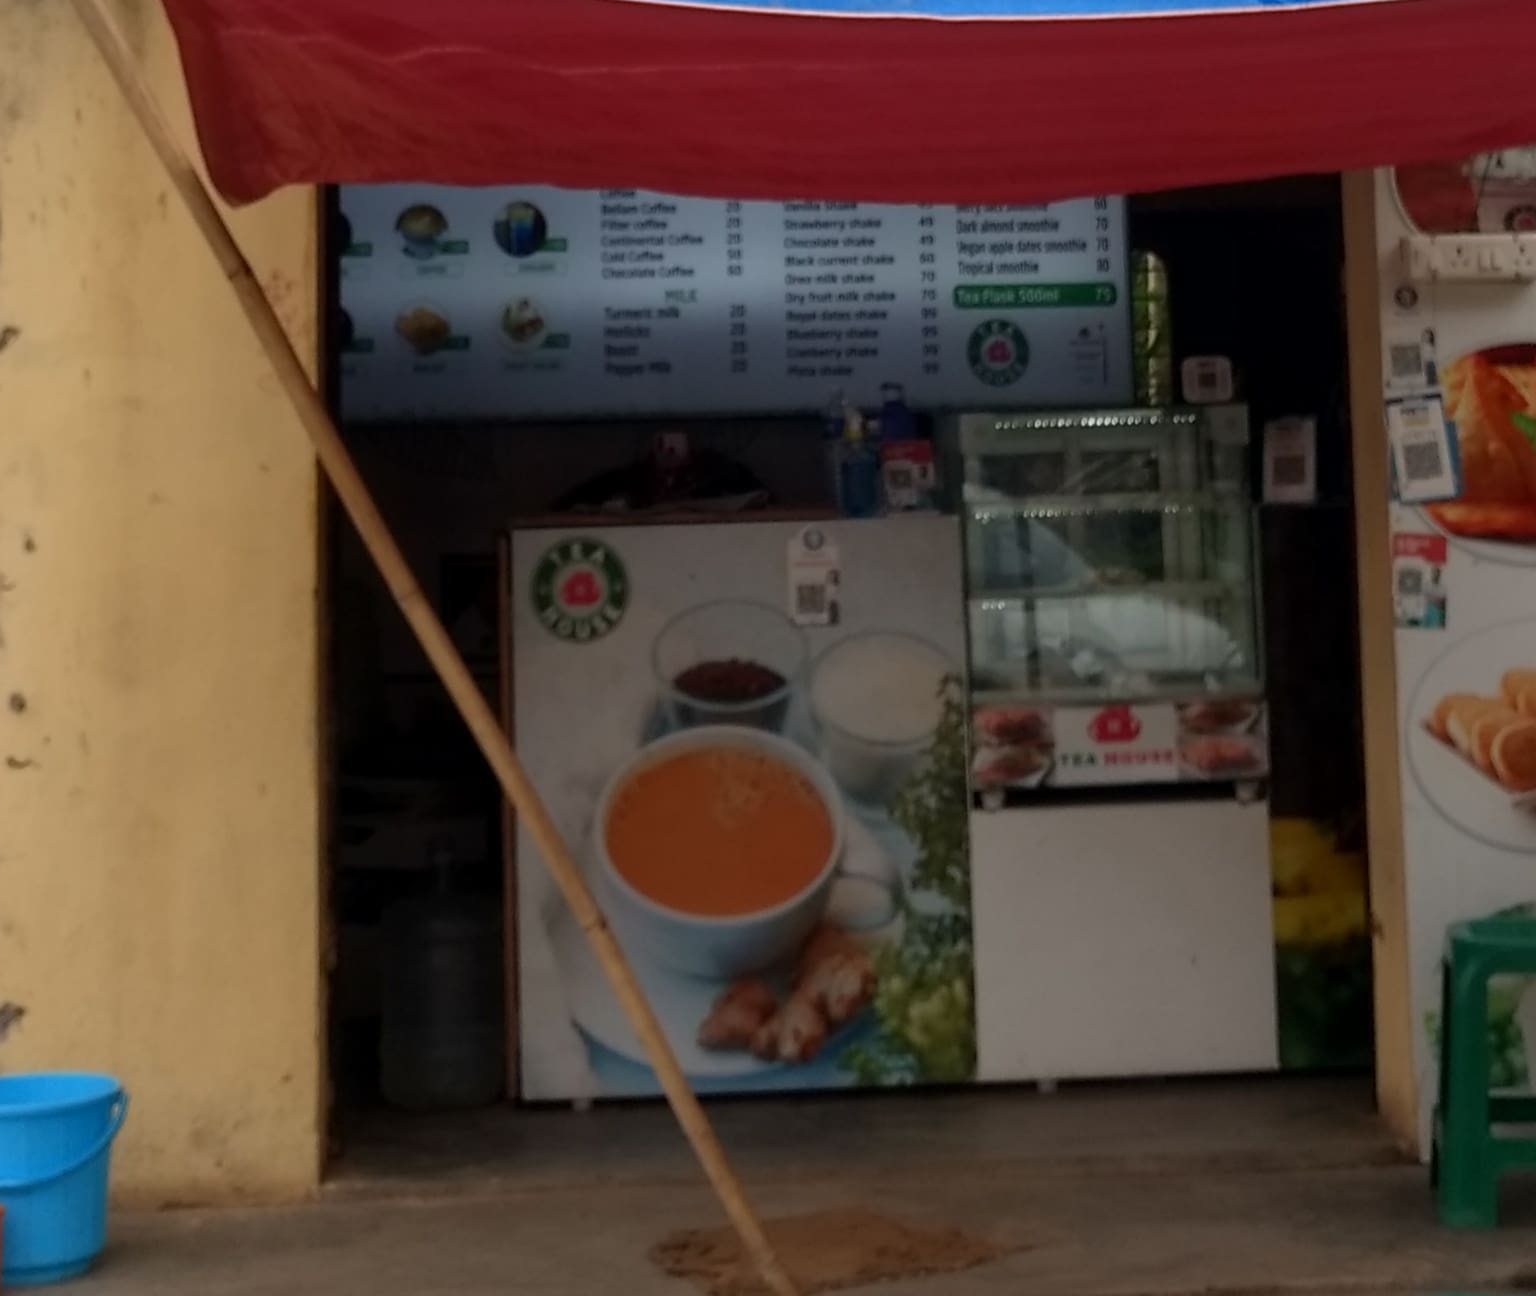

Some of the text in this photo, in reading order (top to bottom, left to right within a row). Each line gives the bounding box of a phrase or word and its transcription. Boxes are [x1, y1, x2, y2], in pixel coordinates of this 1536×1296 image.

[641, 202, 676, 214] Coffee
[601, 219, 629, 230] Filter
[785, 219, 845, 232] Strawberry
[957, 219, 977, 233] Dark
[1017, 218, 1060, 232] smoothie
[601, 235, 663, 247] Continental
[668, 234, 703, 246] Coffee
[784, 238, 839, 249] Chocolate
[1045, 239, 1087, 252] smoothie
[628, 250, 663, 262] Coffee
[785, 256, 814, 267] Black
[602, 267, 655, 279] Chocolate
[658, 266, 694, 278] Coffee
[958, 261, 993, 277] Tropical
[996, 260, 1039, 274] smoothie
[957, 290, 979, 304] Tea
[548, 542, 606, 564] TEA
[541, 605, 622, 640] HOUSE
[1060, 749, 1174, 767] TEA HOUSE
